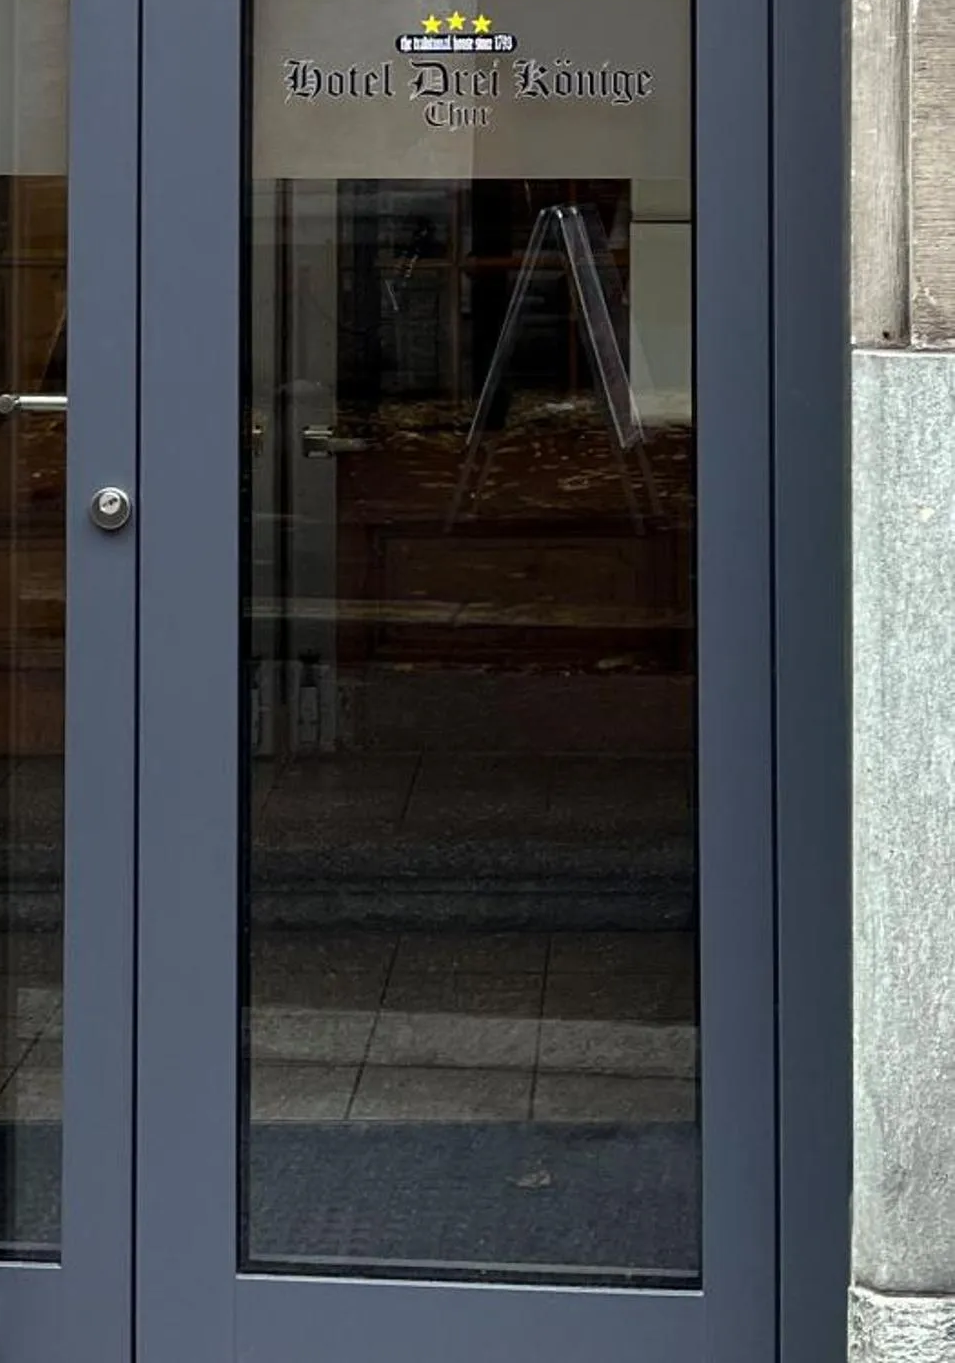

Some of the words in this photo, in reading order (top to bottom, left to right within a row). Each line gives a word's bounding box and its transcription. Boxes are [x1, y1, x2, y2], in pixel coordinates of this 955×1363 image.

[286, 59, 394, 102] Hotel
[409, 60, 499, 100] Drei
[515, 59, 653, 105] Könige
[423, 101, 493, 131] Chur
